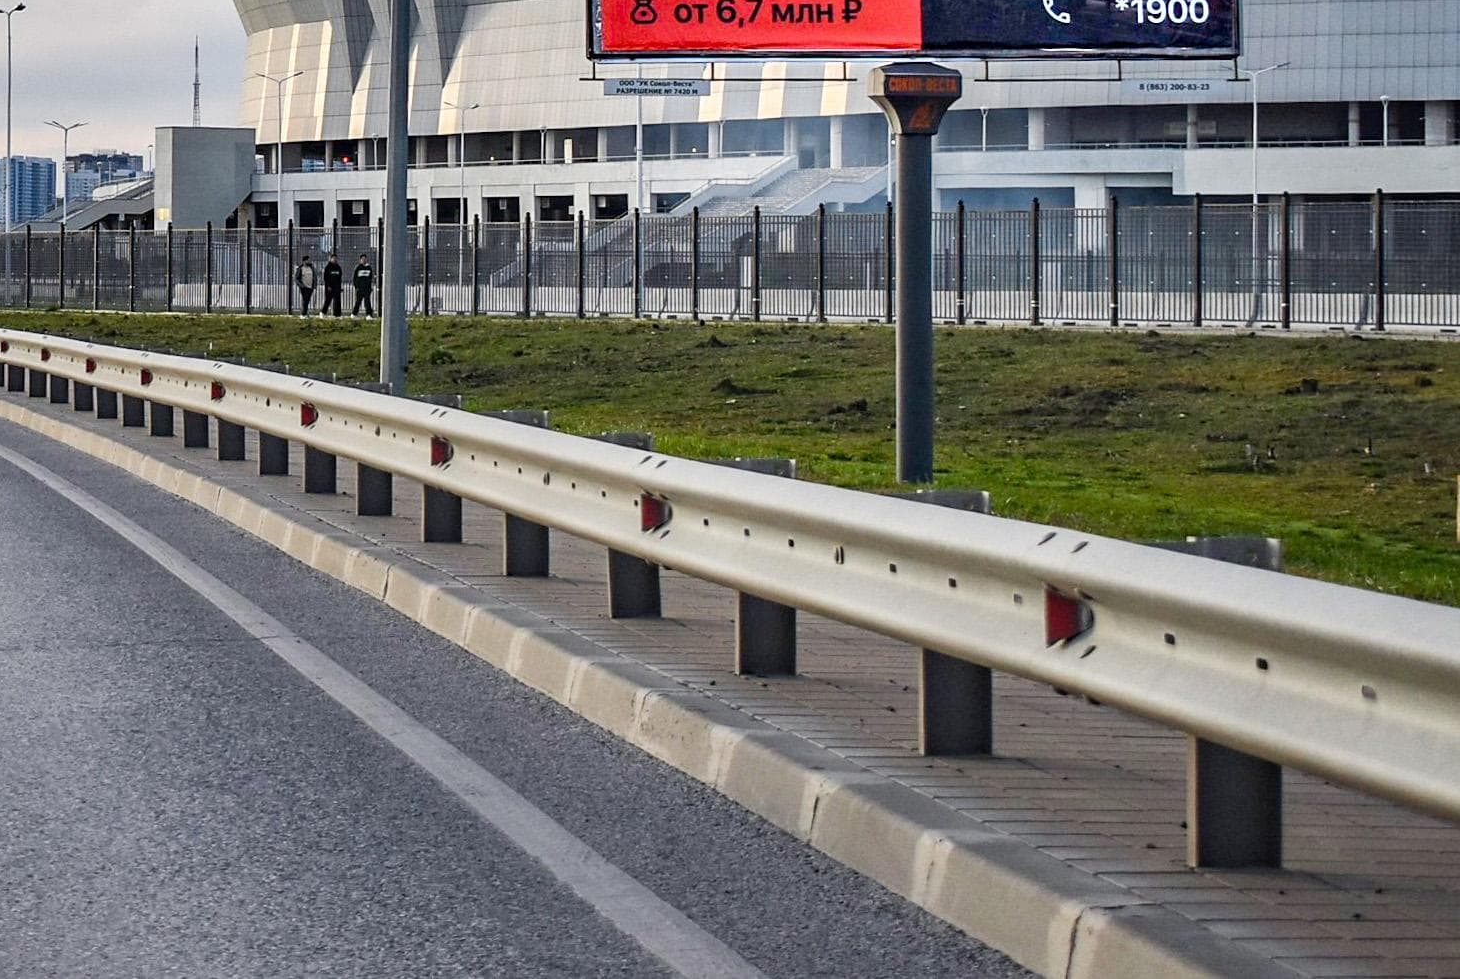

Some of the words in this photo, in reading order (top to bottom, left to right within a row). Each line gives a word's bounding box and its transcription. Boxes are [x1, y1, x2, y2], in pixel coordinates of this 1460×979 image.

[674, 3, 708, 23] от
[771, 3, 834, 23] млн
[1146, 84, 1169, 92] (863)
